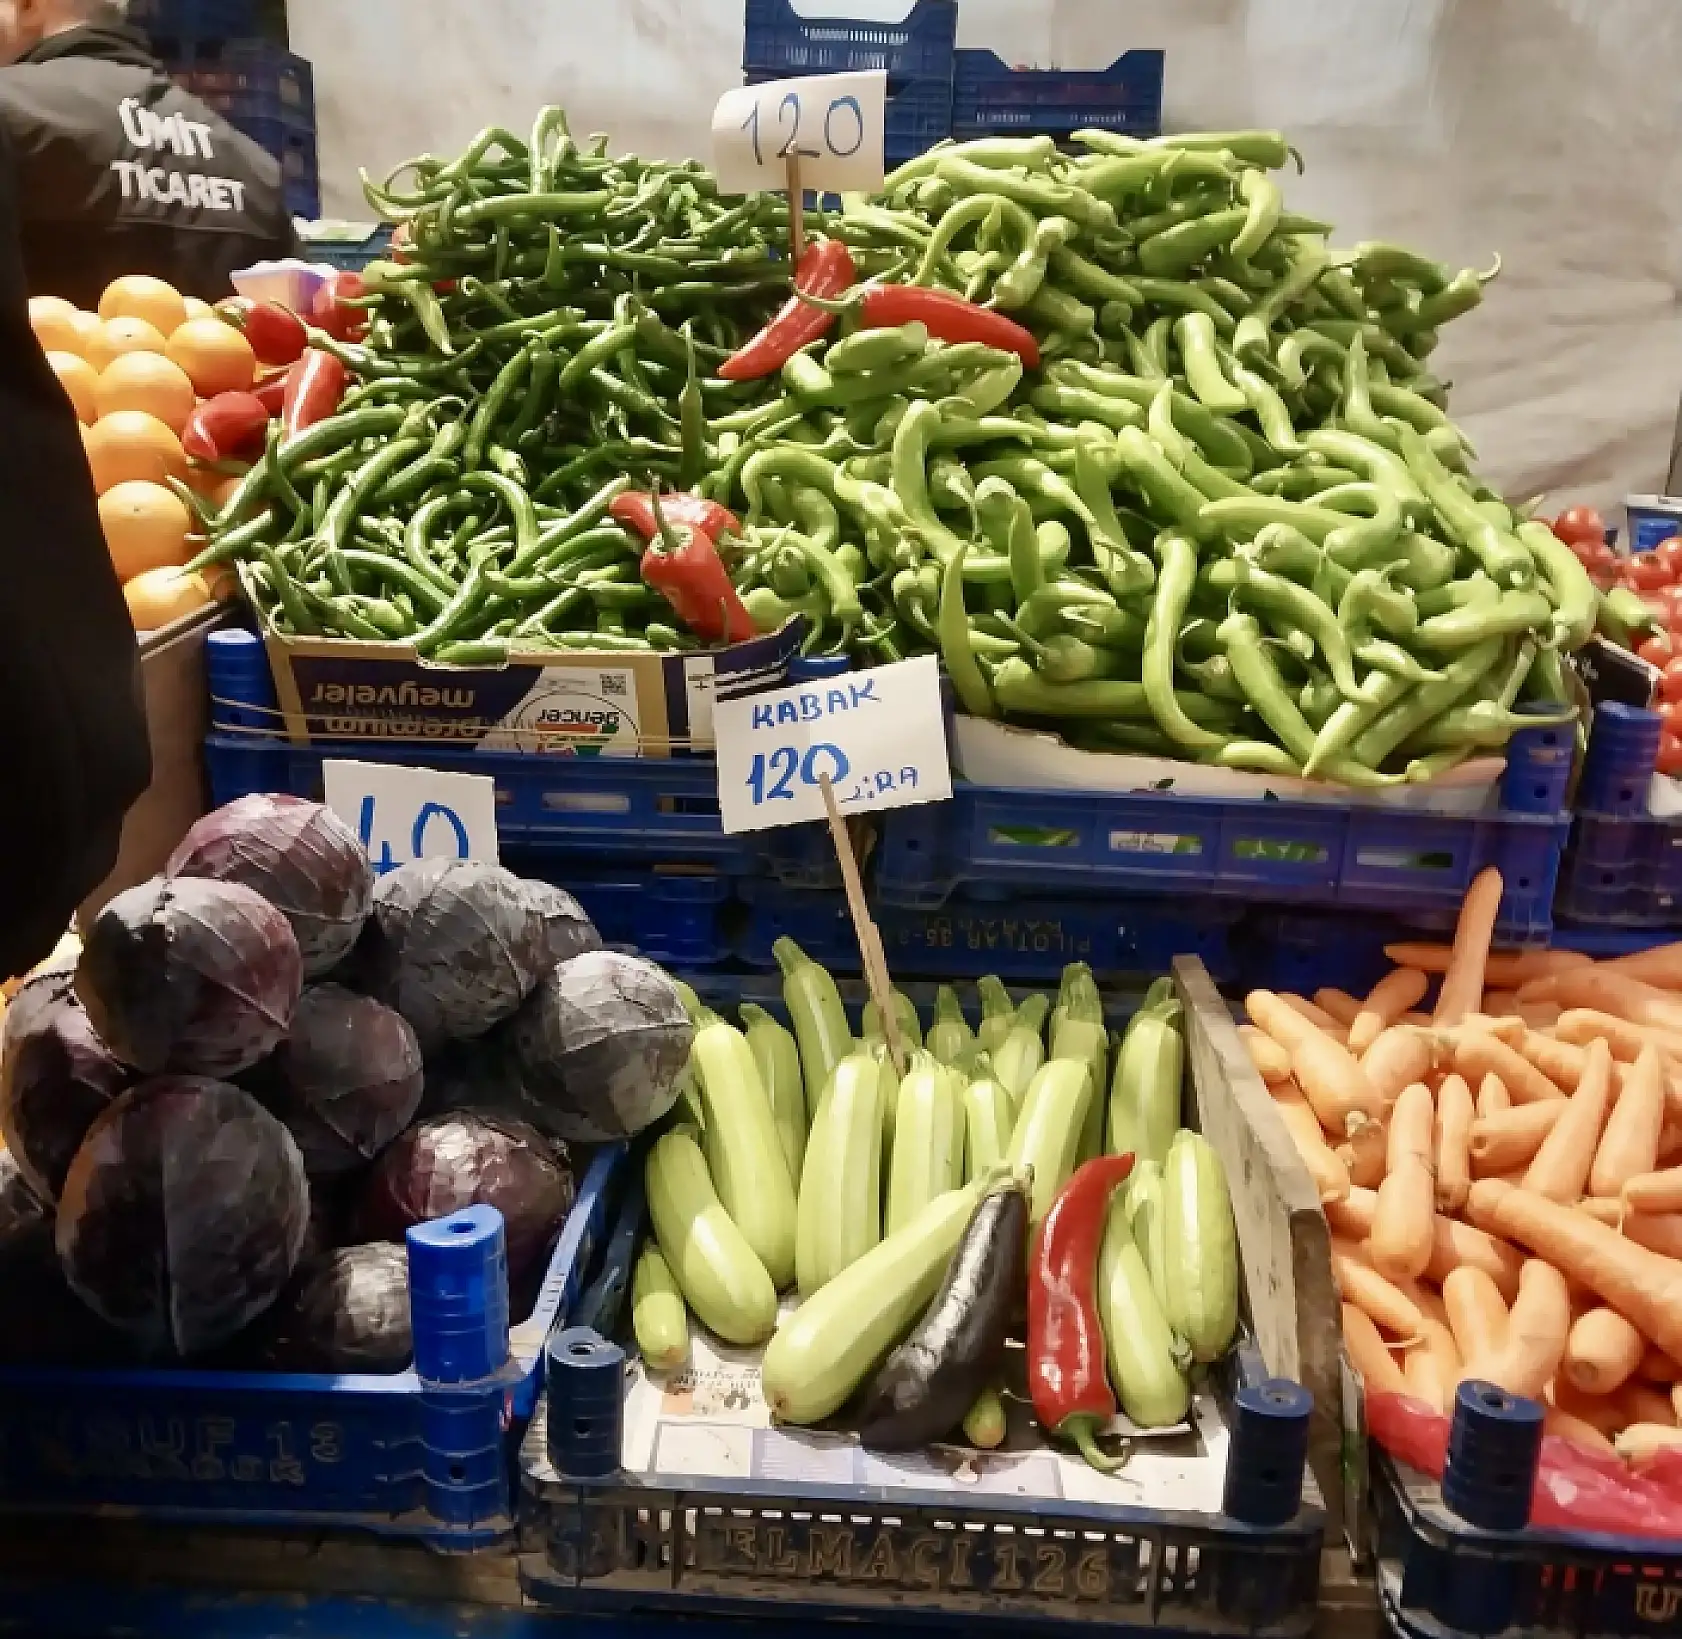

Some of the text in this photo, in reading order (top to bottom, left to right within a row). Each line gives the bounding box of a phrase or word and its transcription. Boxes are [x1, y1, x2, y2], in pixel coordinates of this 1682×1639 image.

[741, 93, 863, 165] 120
[310, 678, 476, 708] meyveler
[752, 678, 882, 729] KABAK
[745, 743, 850, 805] 120
[993, 1540, 1108, 1594] 126
